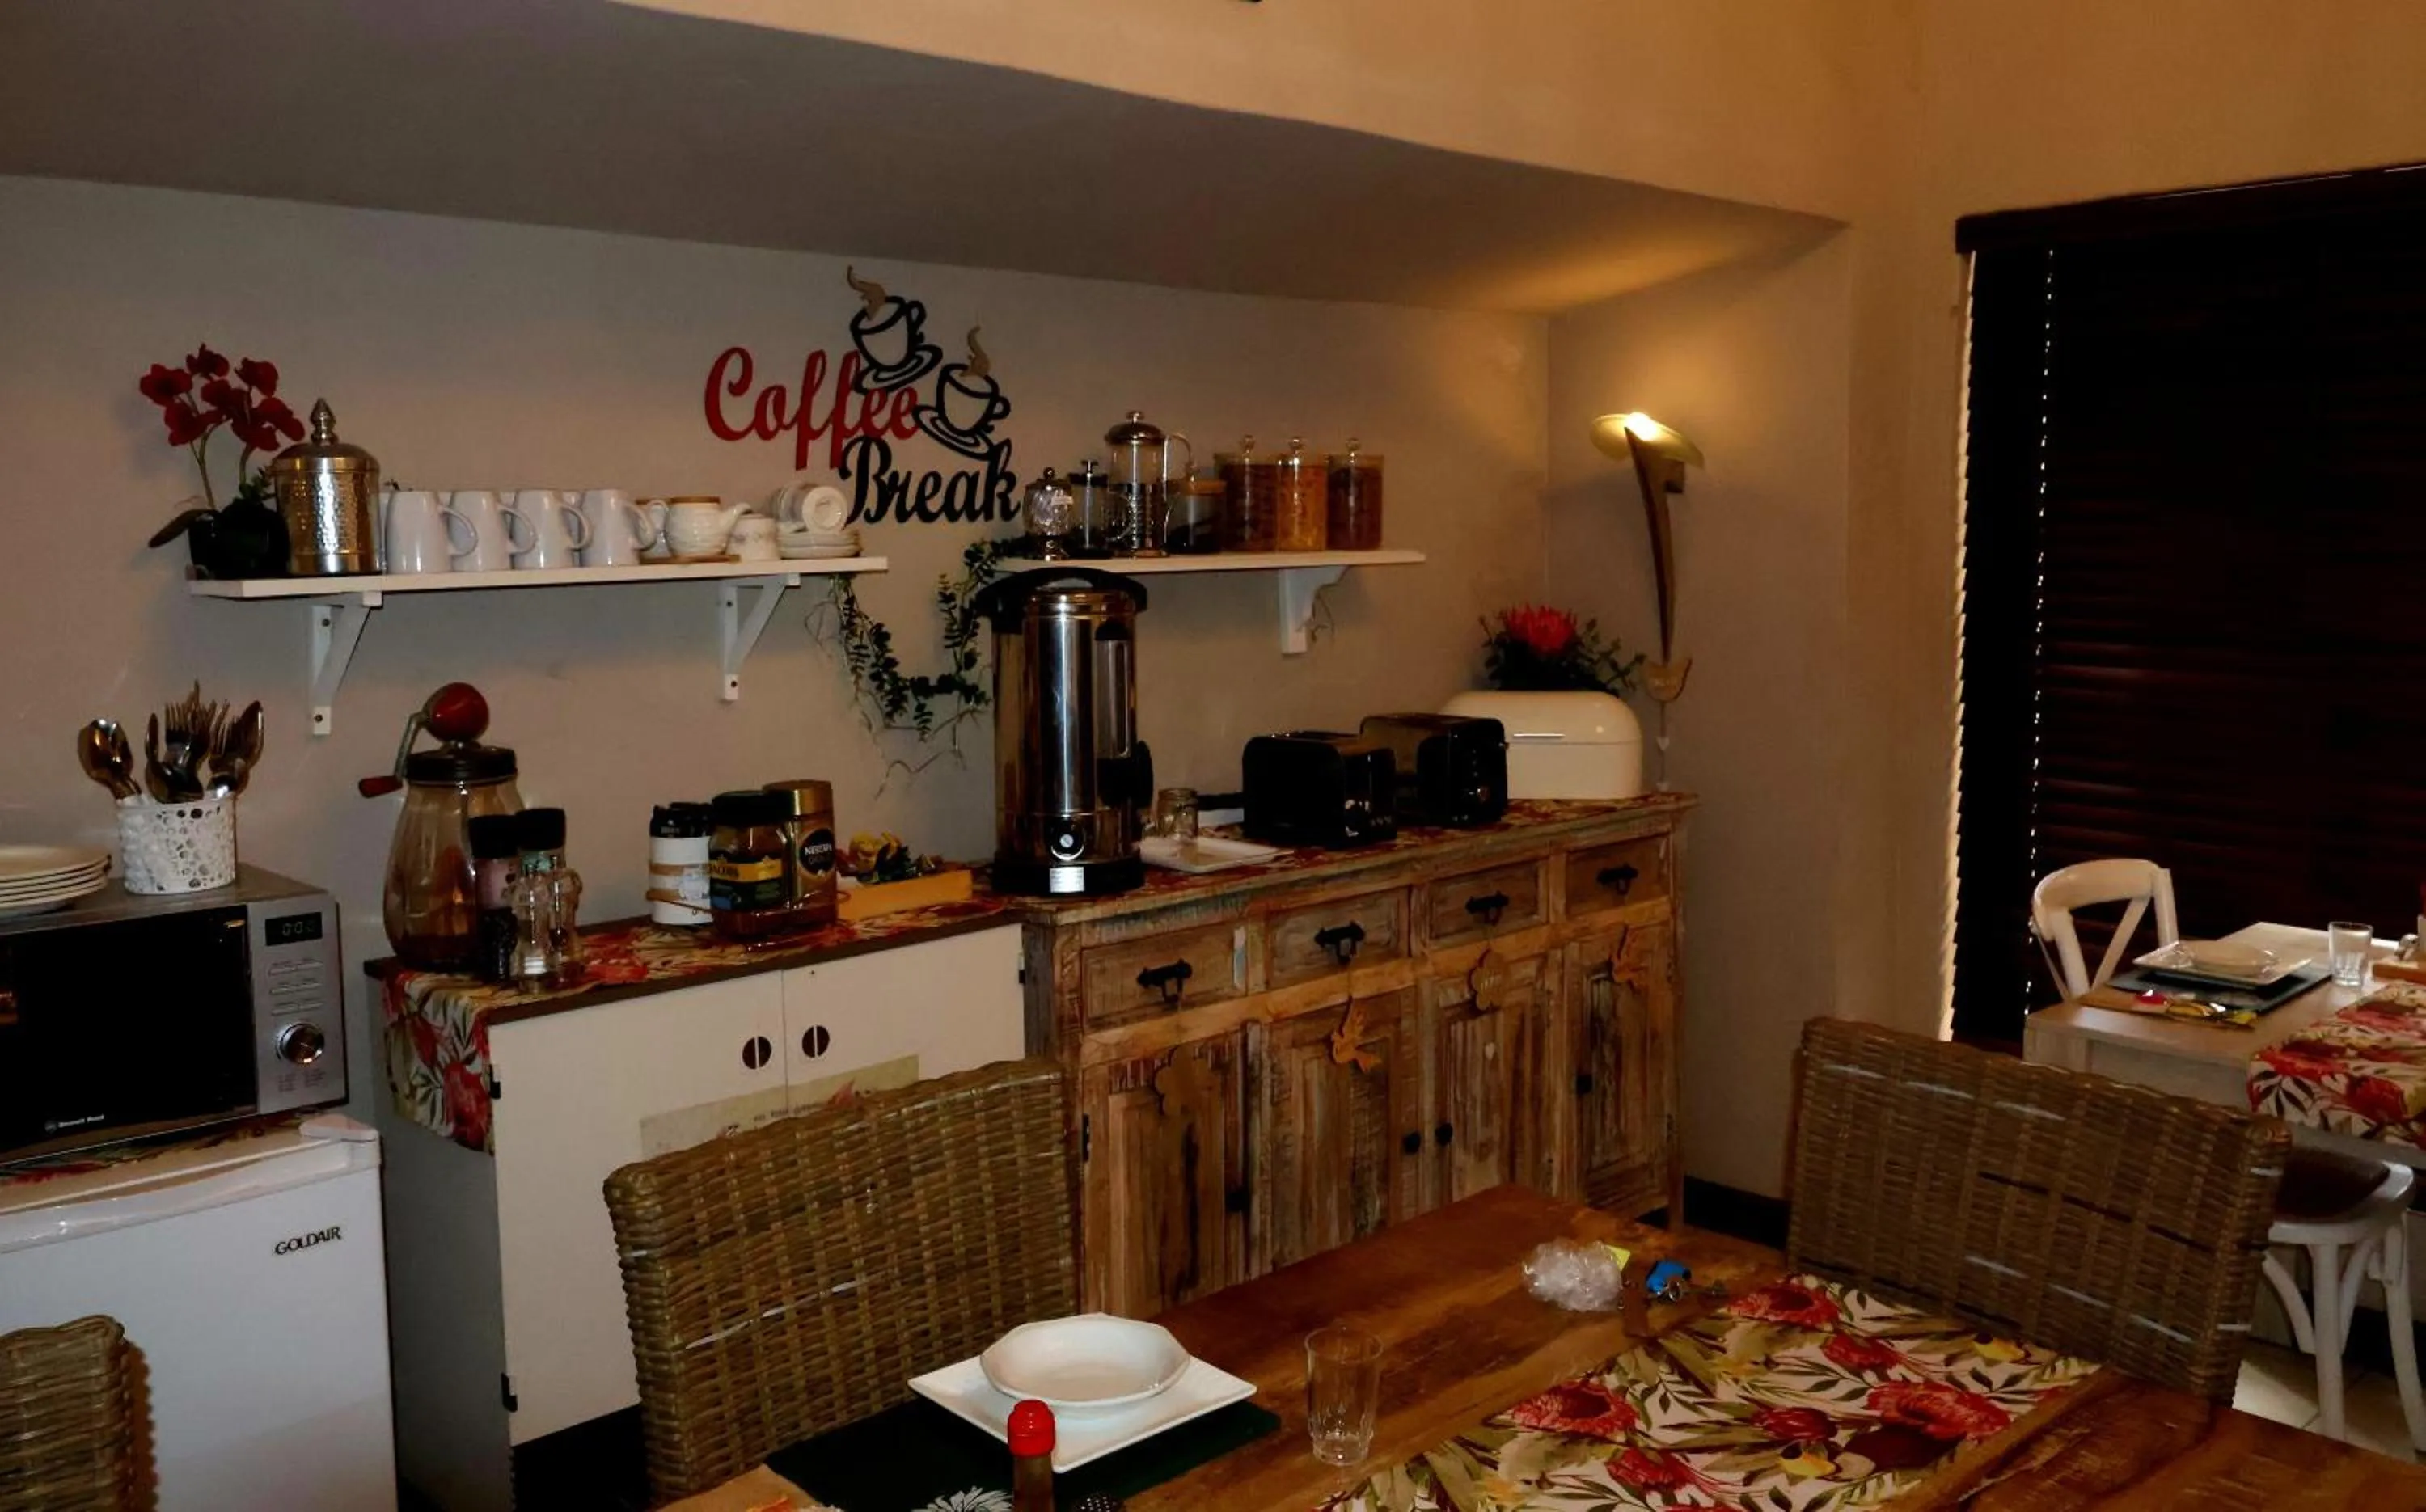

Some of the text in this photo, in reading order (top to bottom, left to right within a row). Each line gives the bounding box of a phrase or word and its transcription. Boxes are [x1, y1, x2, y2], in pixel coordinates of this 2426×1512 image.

[704, 347, 920, 471] Coffee
[839, 435, 1020, 531] Break
[275, 1226, 341, 1255] GOLDAIR
